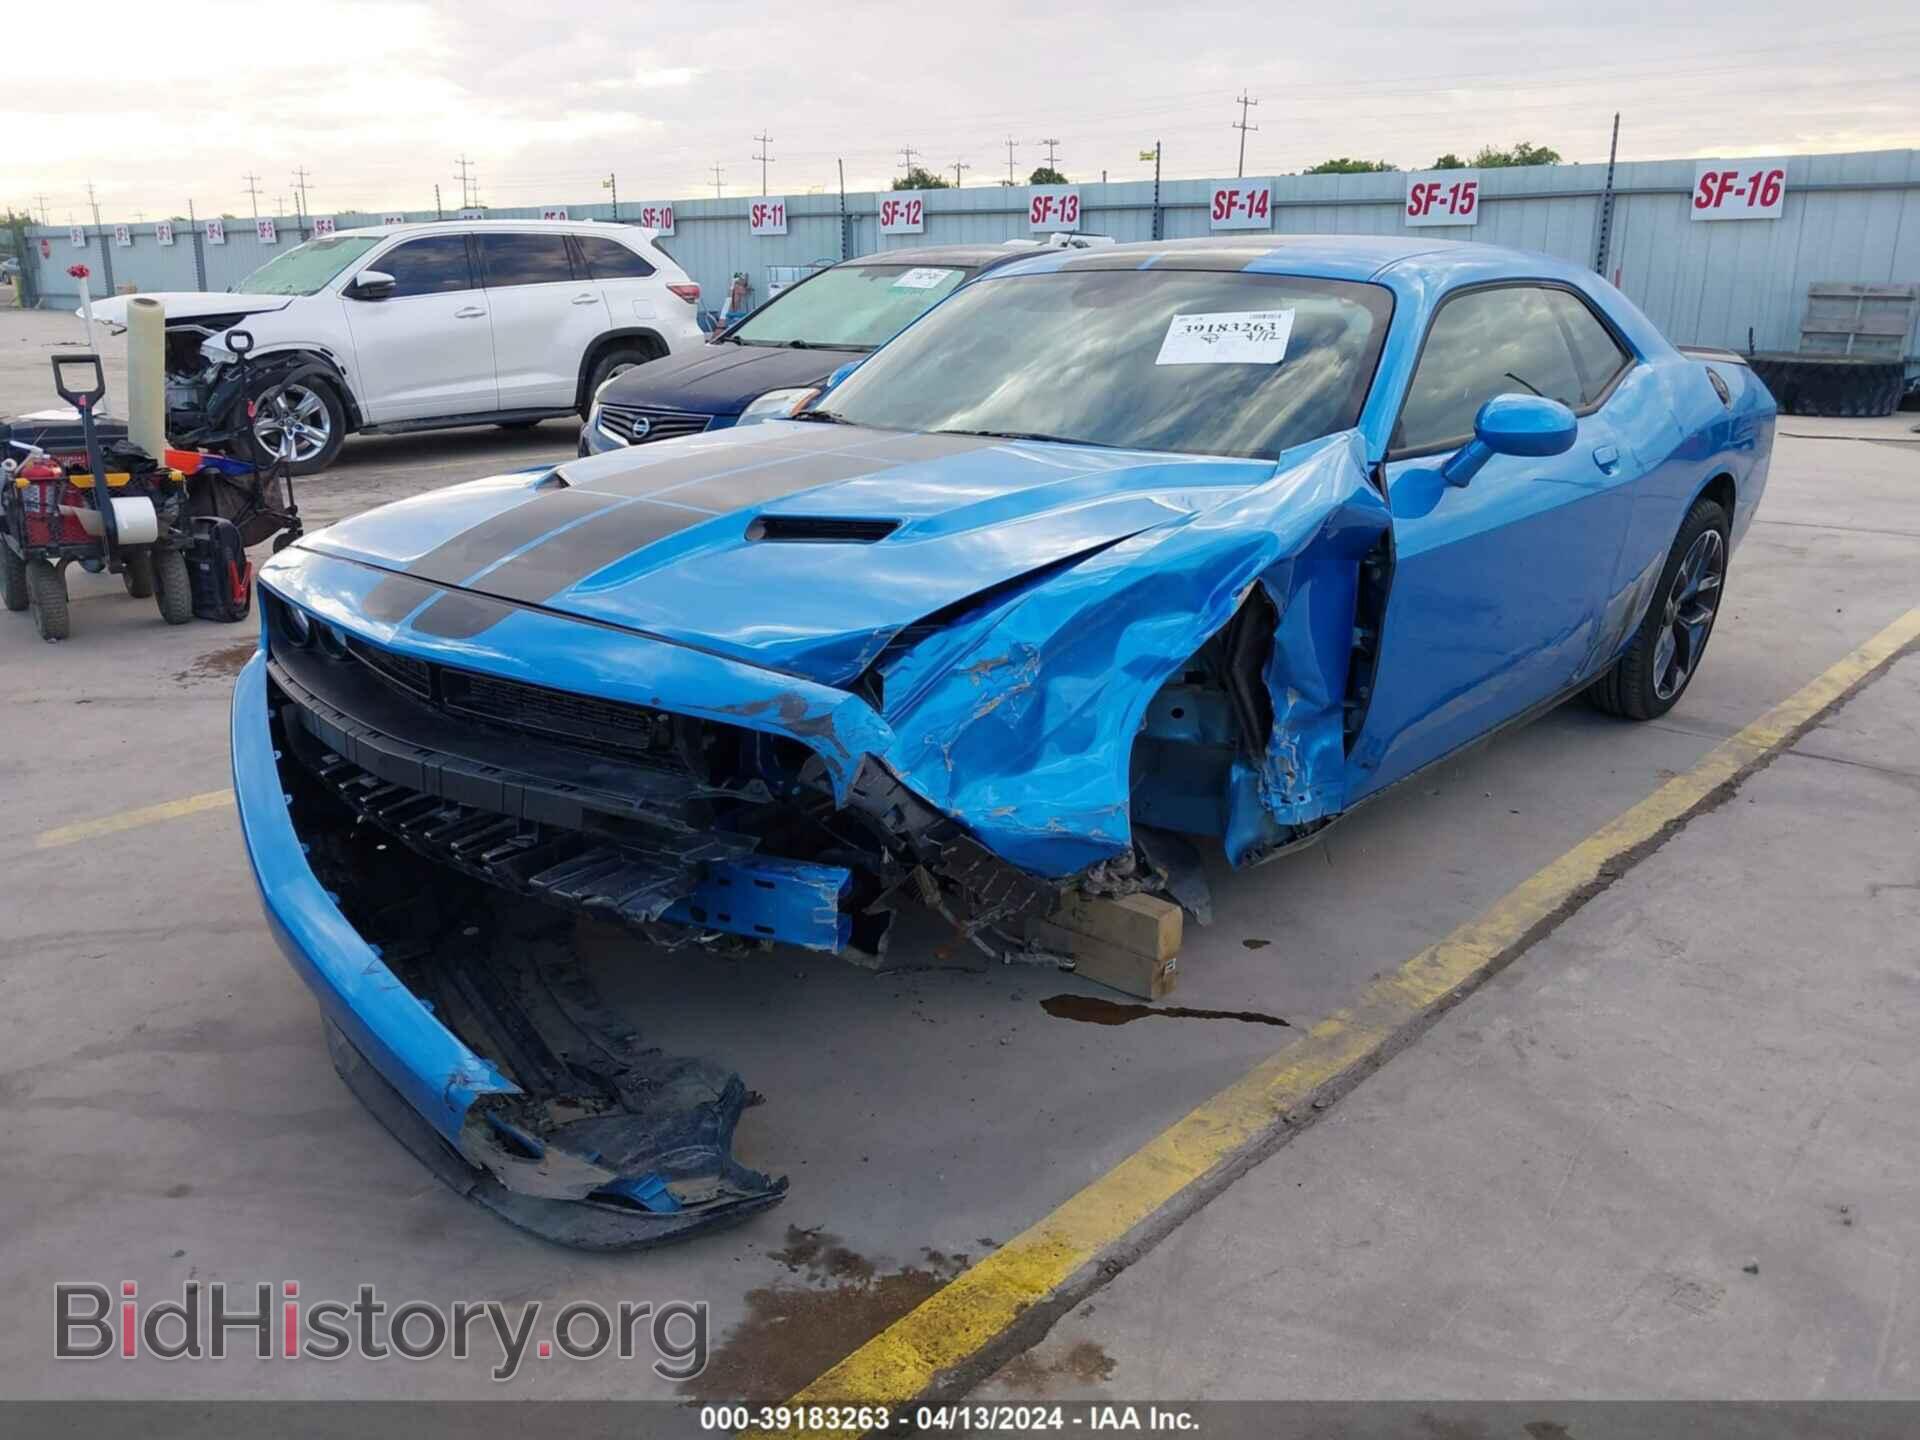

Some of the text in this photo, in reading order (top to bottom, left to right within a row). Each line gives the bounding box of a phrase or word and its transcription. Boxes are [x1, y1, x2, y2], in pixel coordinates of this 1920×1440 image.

[1407, 181, 1478, 217] SF-15
[1694, 169, 1785, 209] SF-16
[642, 206, 672, 229] SF-10
[752, 203, 784, 228] SF-11
[881, 199, 922, 226] SF-12
[1031, 194, 1079, 224] SF-13
[1212, 189, 1269, 221] SF-14
[1184, 321, 1277, 334] 39183263
